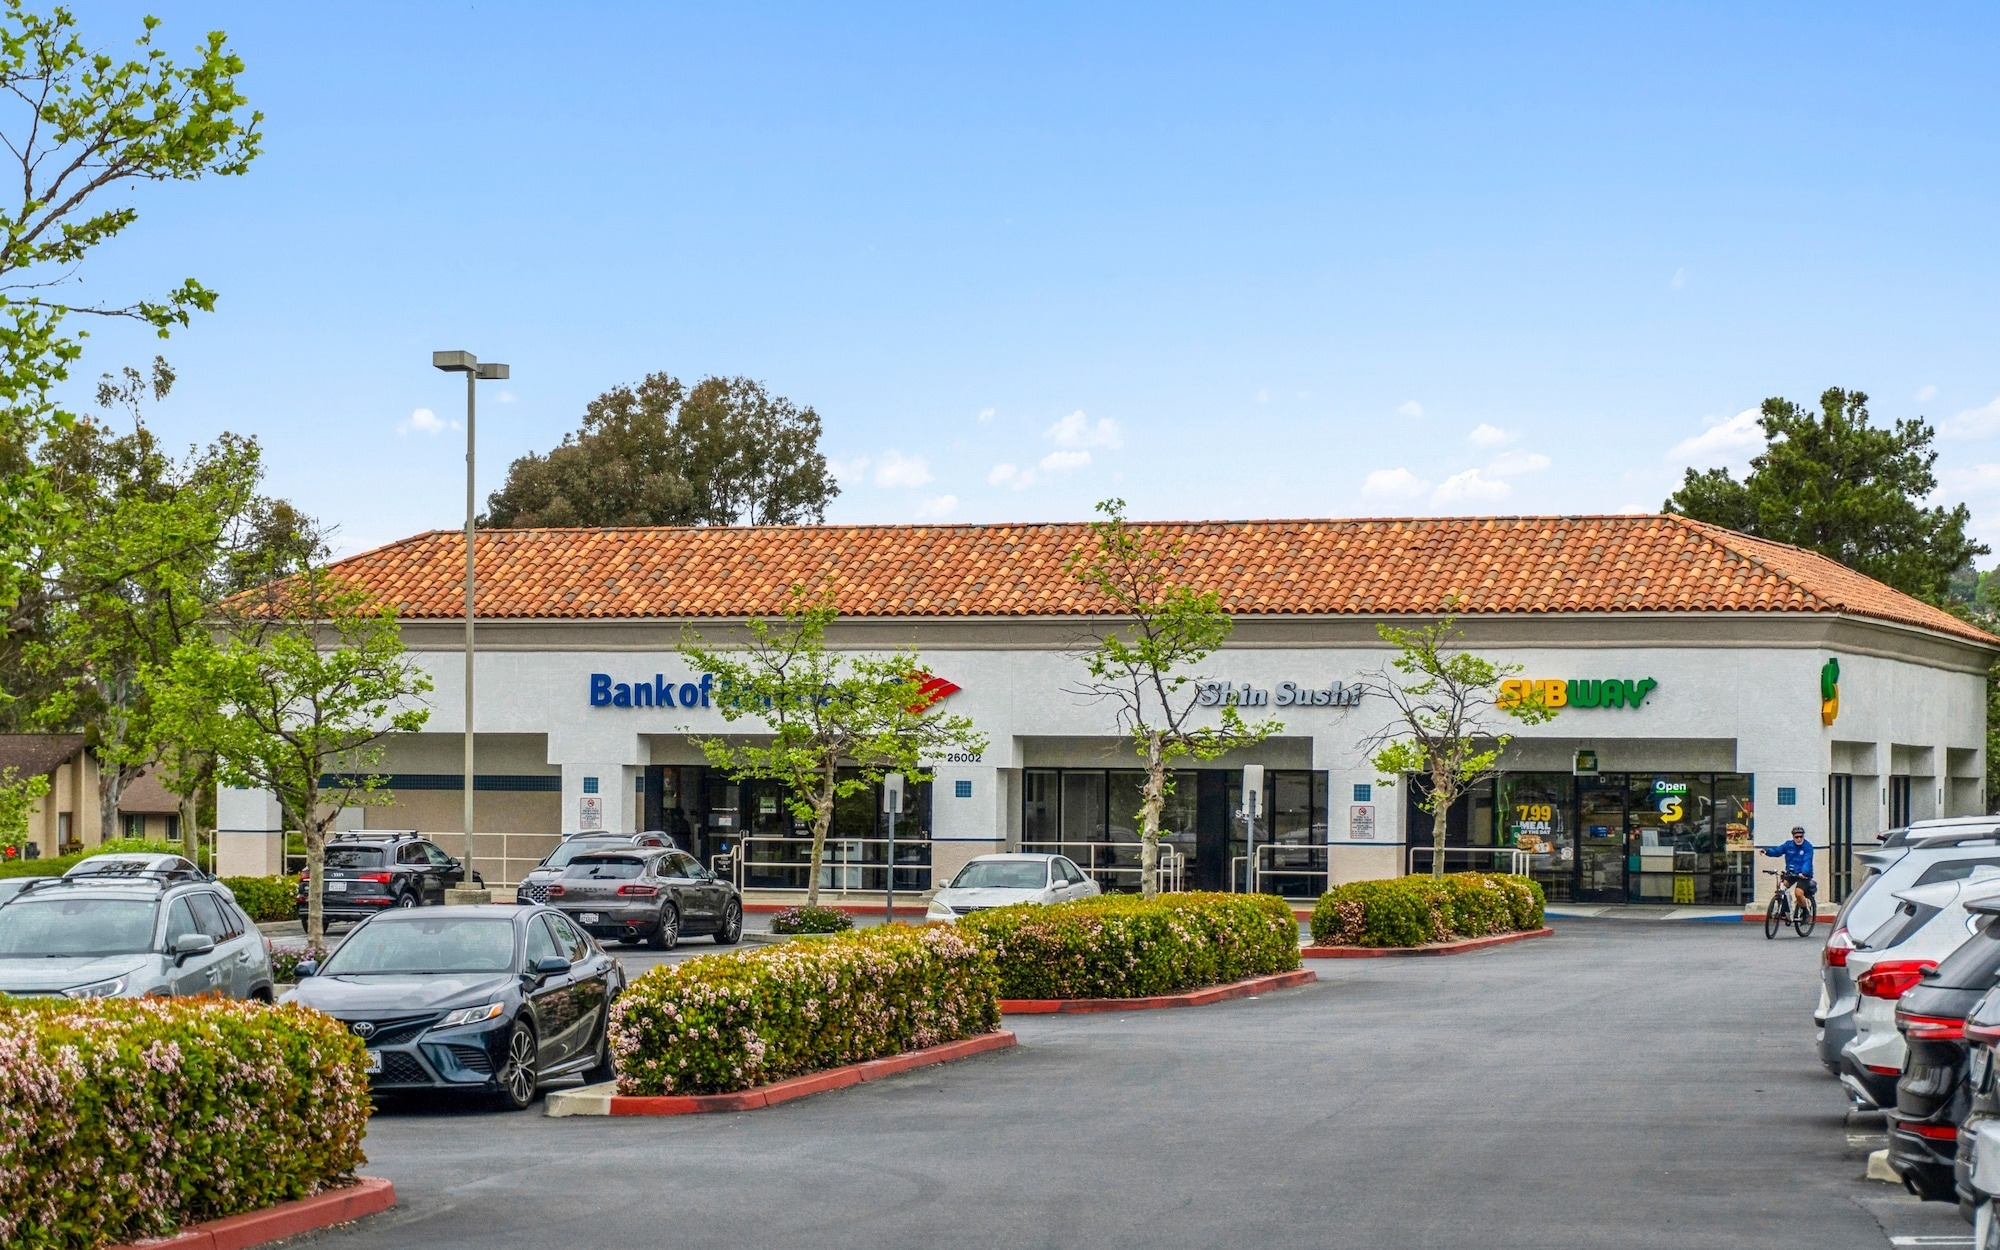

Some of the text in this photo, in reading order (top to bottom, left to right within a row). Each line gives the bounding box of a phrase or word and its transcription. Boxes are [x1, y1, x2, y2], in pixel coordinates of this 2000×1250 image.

[590, 673, 676, 708] Bank
[678, 673, 713, 708] of
[1200, 681, 1362, 706] Shin Sushi
[1497, 676, 1658, 709] SUBWAY
[947, 753, 982, 763] 26002
[1656, 781, 1687, 793] Open
[1516, 804, 1552, 821] $7.99
[1520, 821, 1551, 829] MEAL
